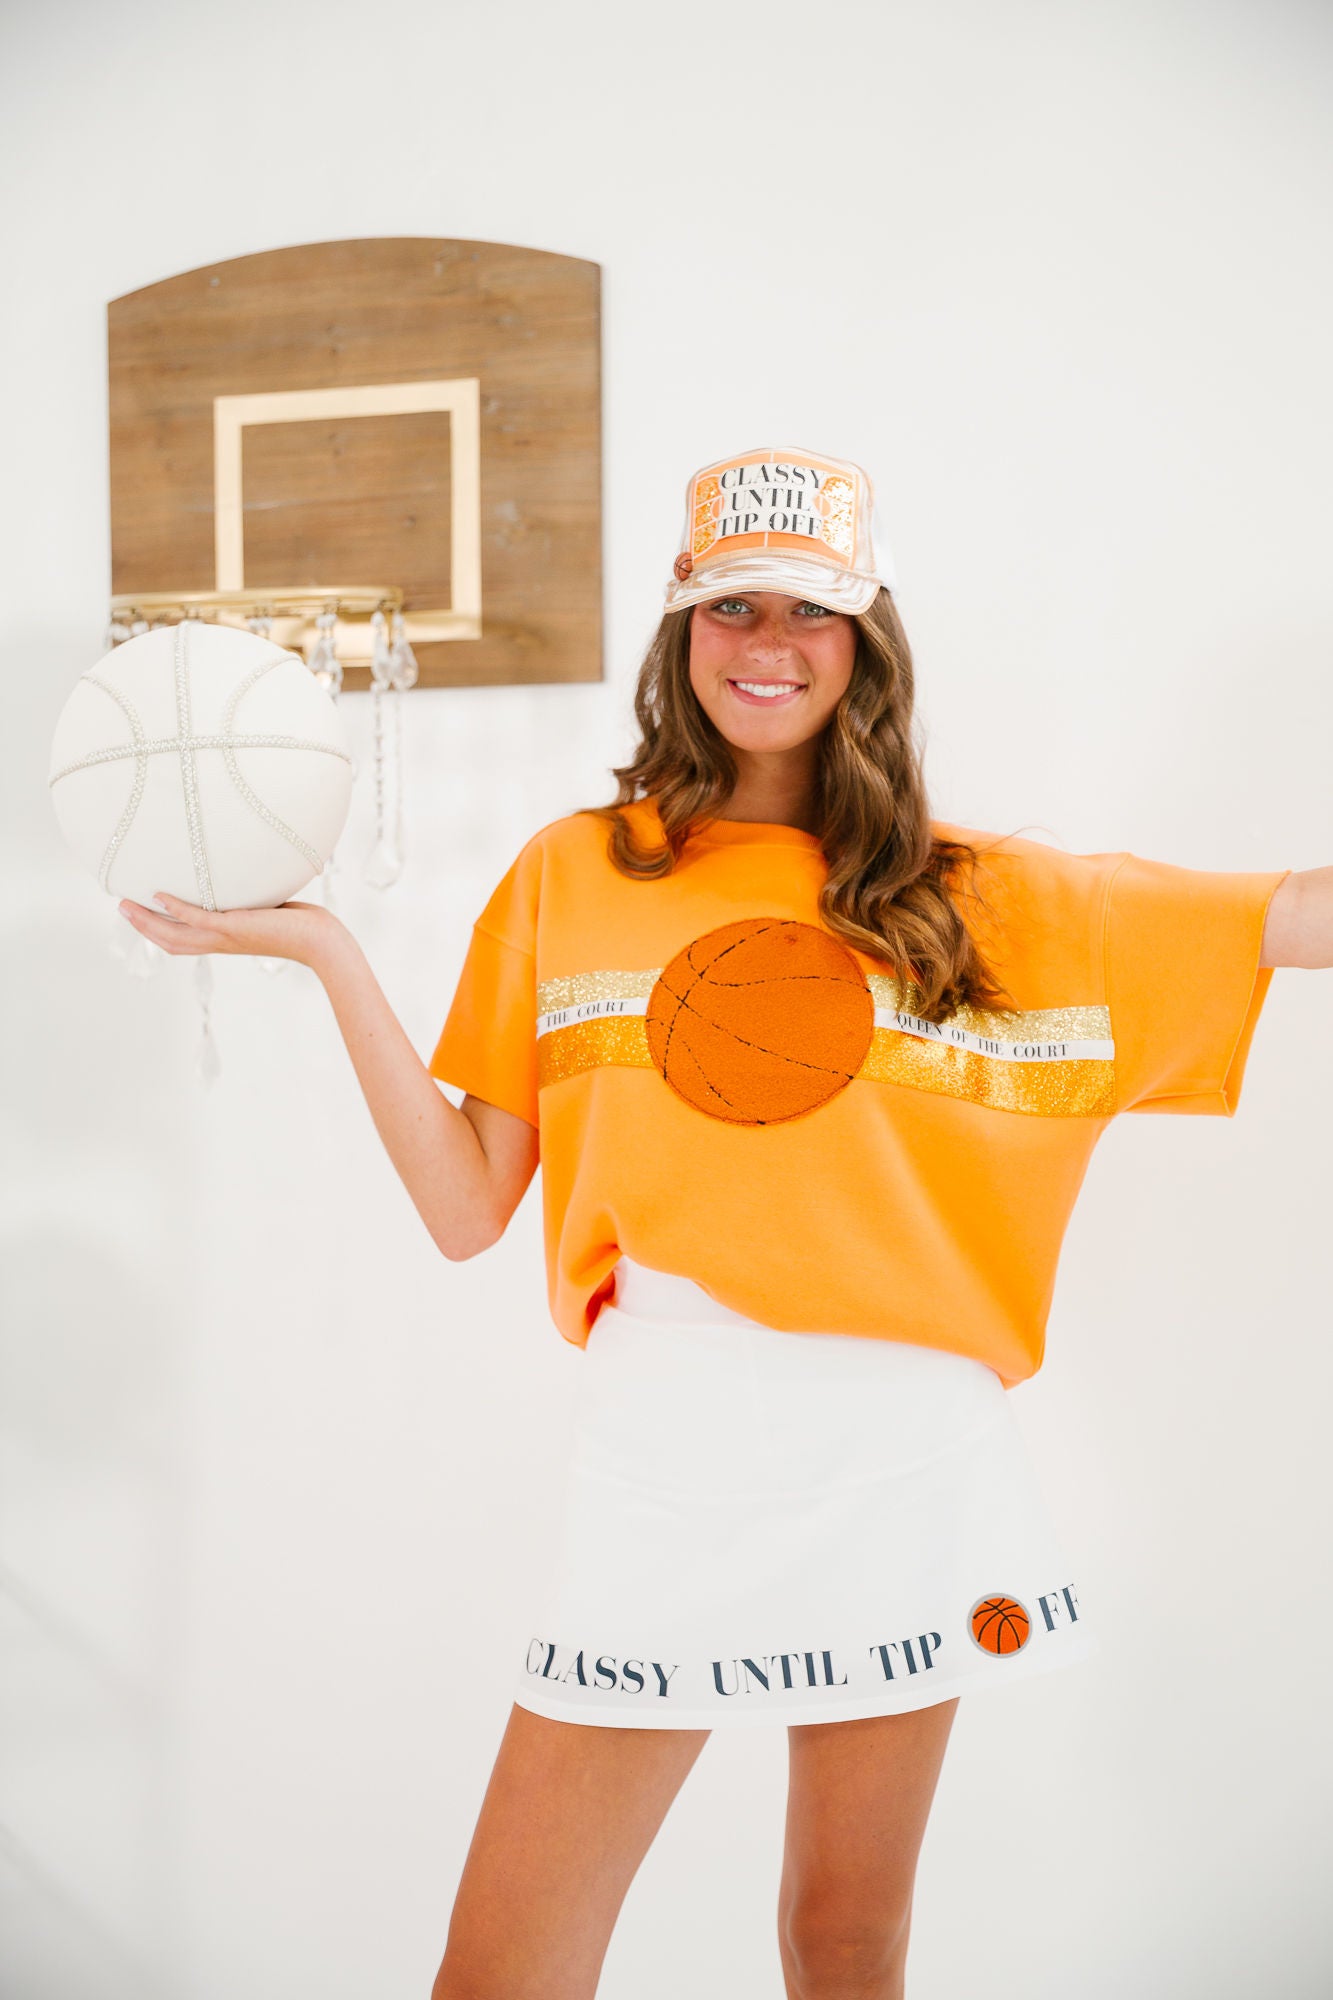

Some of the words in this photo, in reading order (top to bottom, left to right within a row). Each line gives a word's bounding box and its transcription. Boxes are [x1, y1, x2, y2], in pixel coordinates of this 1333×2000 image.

[721, 464, 824, 489] CLASSY
[731, 488, 811, 511] UNTIL
[718, 512, 759, 536] TIP
[769, 512, 822, 535] OFF
[545, 1007, 570, 1028] THE
[577, 1001, 627, 1017] COURT
[897, 1013, 943, 1037] QUEEN
[951, 1029, 967, 1043] OF
[976, 1037, 1004, 1055] THE
[1013, 1044, 1069, 1058] COURT
[526, 1638, 680, 1698] CLASSY
[710, 1650, 848, 1696] UNTIL
[869, 1631, 942, 1682] TIP
